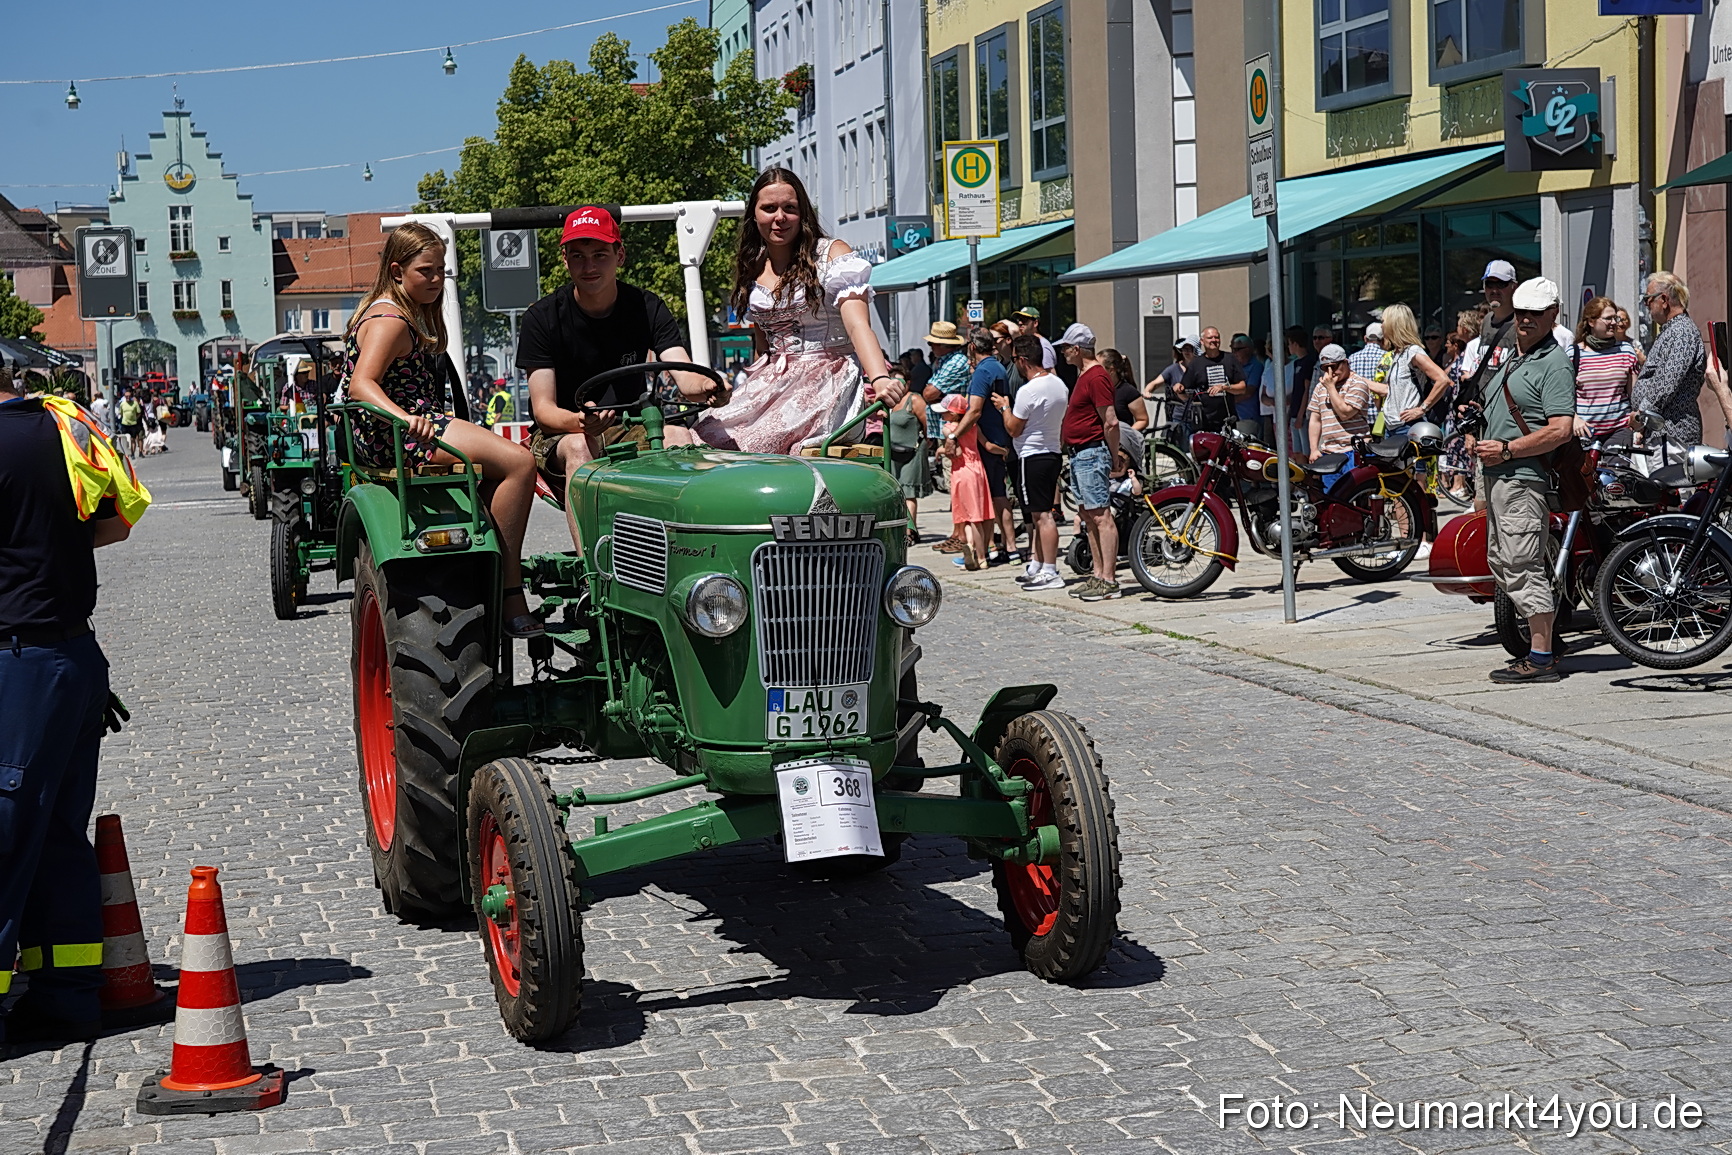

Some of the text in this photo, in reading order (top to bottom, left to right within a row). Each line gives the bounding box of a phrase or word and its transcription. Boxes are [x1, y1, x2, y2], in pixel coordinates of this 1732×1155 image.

[1254, 79, 1264, 113] H
[1544, 95, 1577, 136] G2
[963, 156, 980, 179] H
[572, 216, 600, 228] DEKRA
[903, 228, 920, 248] G2
[96, 266, 117, 274] ZONE
[501, 259, 521, 267] ZONE
[771, 515, 876, 540] FENDT
[785, 690, 832, 713] LAU
[776, 711, 859, 737] G 1962
[833, 777, 862, 799] 368
